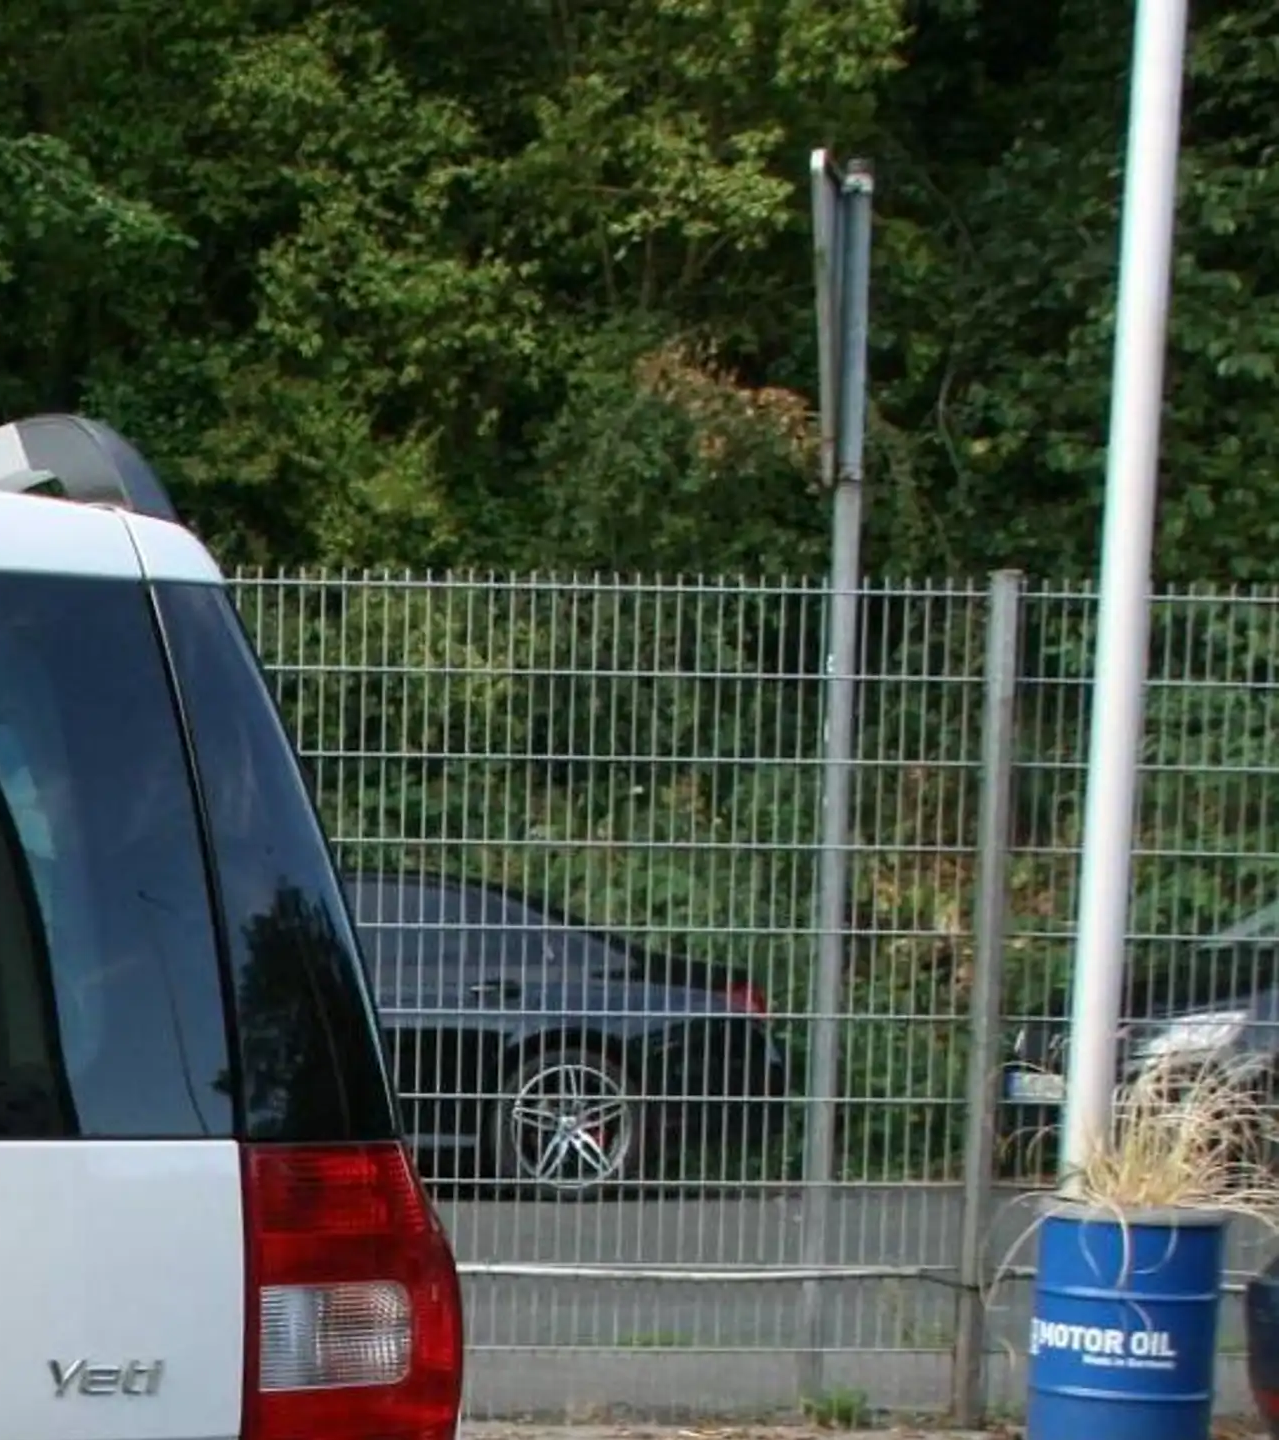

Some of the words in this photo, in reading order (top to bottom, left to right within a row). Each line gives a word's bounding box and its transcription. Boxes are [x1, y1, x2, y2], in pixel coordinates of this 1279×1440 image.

[1039, 1321, 1124, 1355] MOTOR
[1130, 1331, 1177, 1357] OIL
[47, 1359, 164, 1398] Yeti
